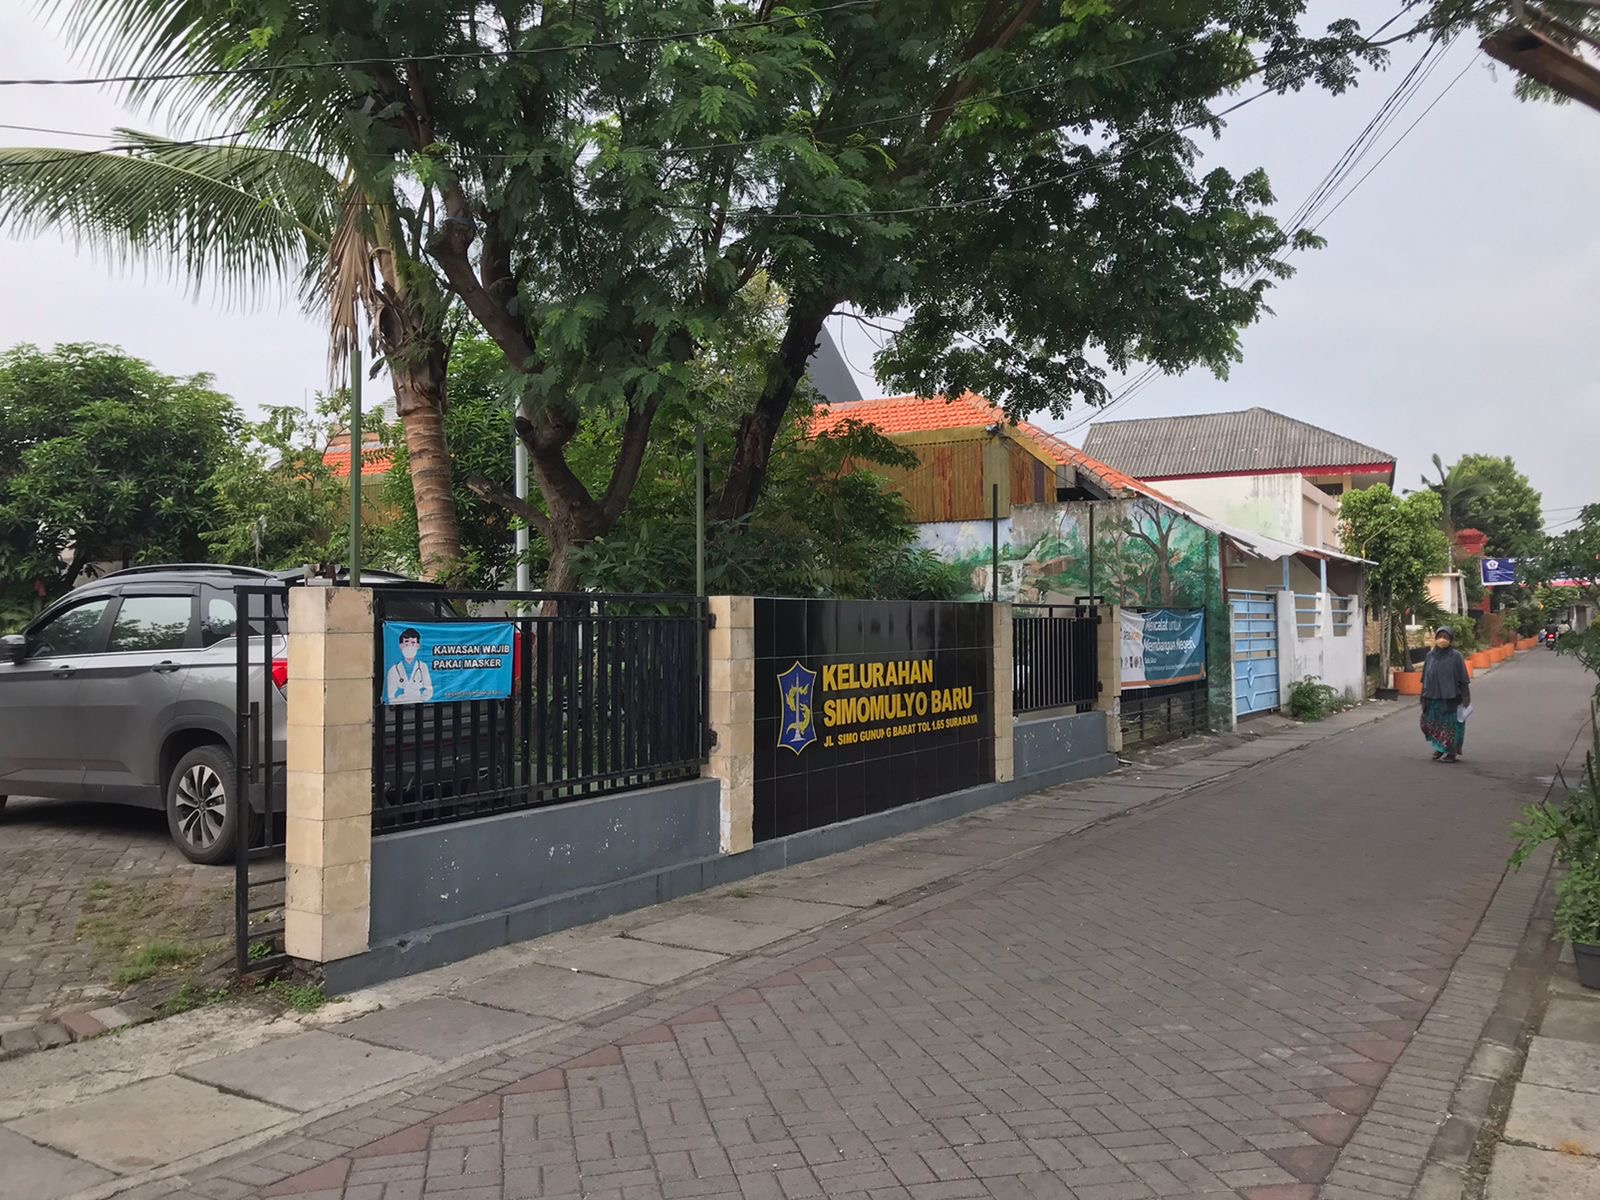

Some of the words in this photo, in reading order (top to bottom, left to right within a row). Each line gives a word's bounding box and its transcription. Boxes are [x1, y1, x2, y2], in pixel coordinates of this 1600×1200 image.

[433, 645, 480, 655] KAWASAN
[481, 644, 510, 654] WAJIB
[1144, 638, 1175, 655] Membangun
[433, 660, 462, 670] PAKAI
[463, 659, 501, 669] MASKER
[822, 659, 933, 692] KELURAHAN
[823, 691, 928, 728] SIMOMULYO
[931, 686, 973, 714] BARU
[838, 732, 858, 746] SIMO
[892, 723, 916, 737] BARAT
[917, 721, 931, 733] TOL
[945, 713, 978, 728] SURABAYA
